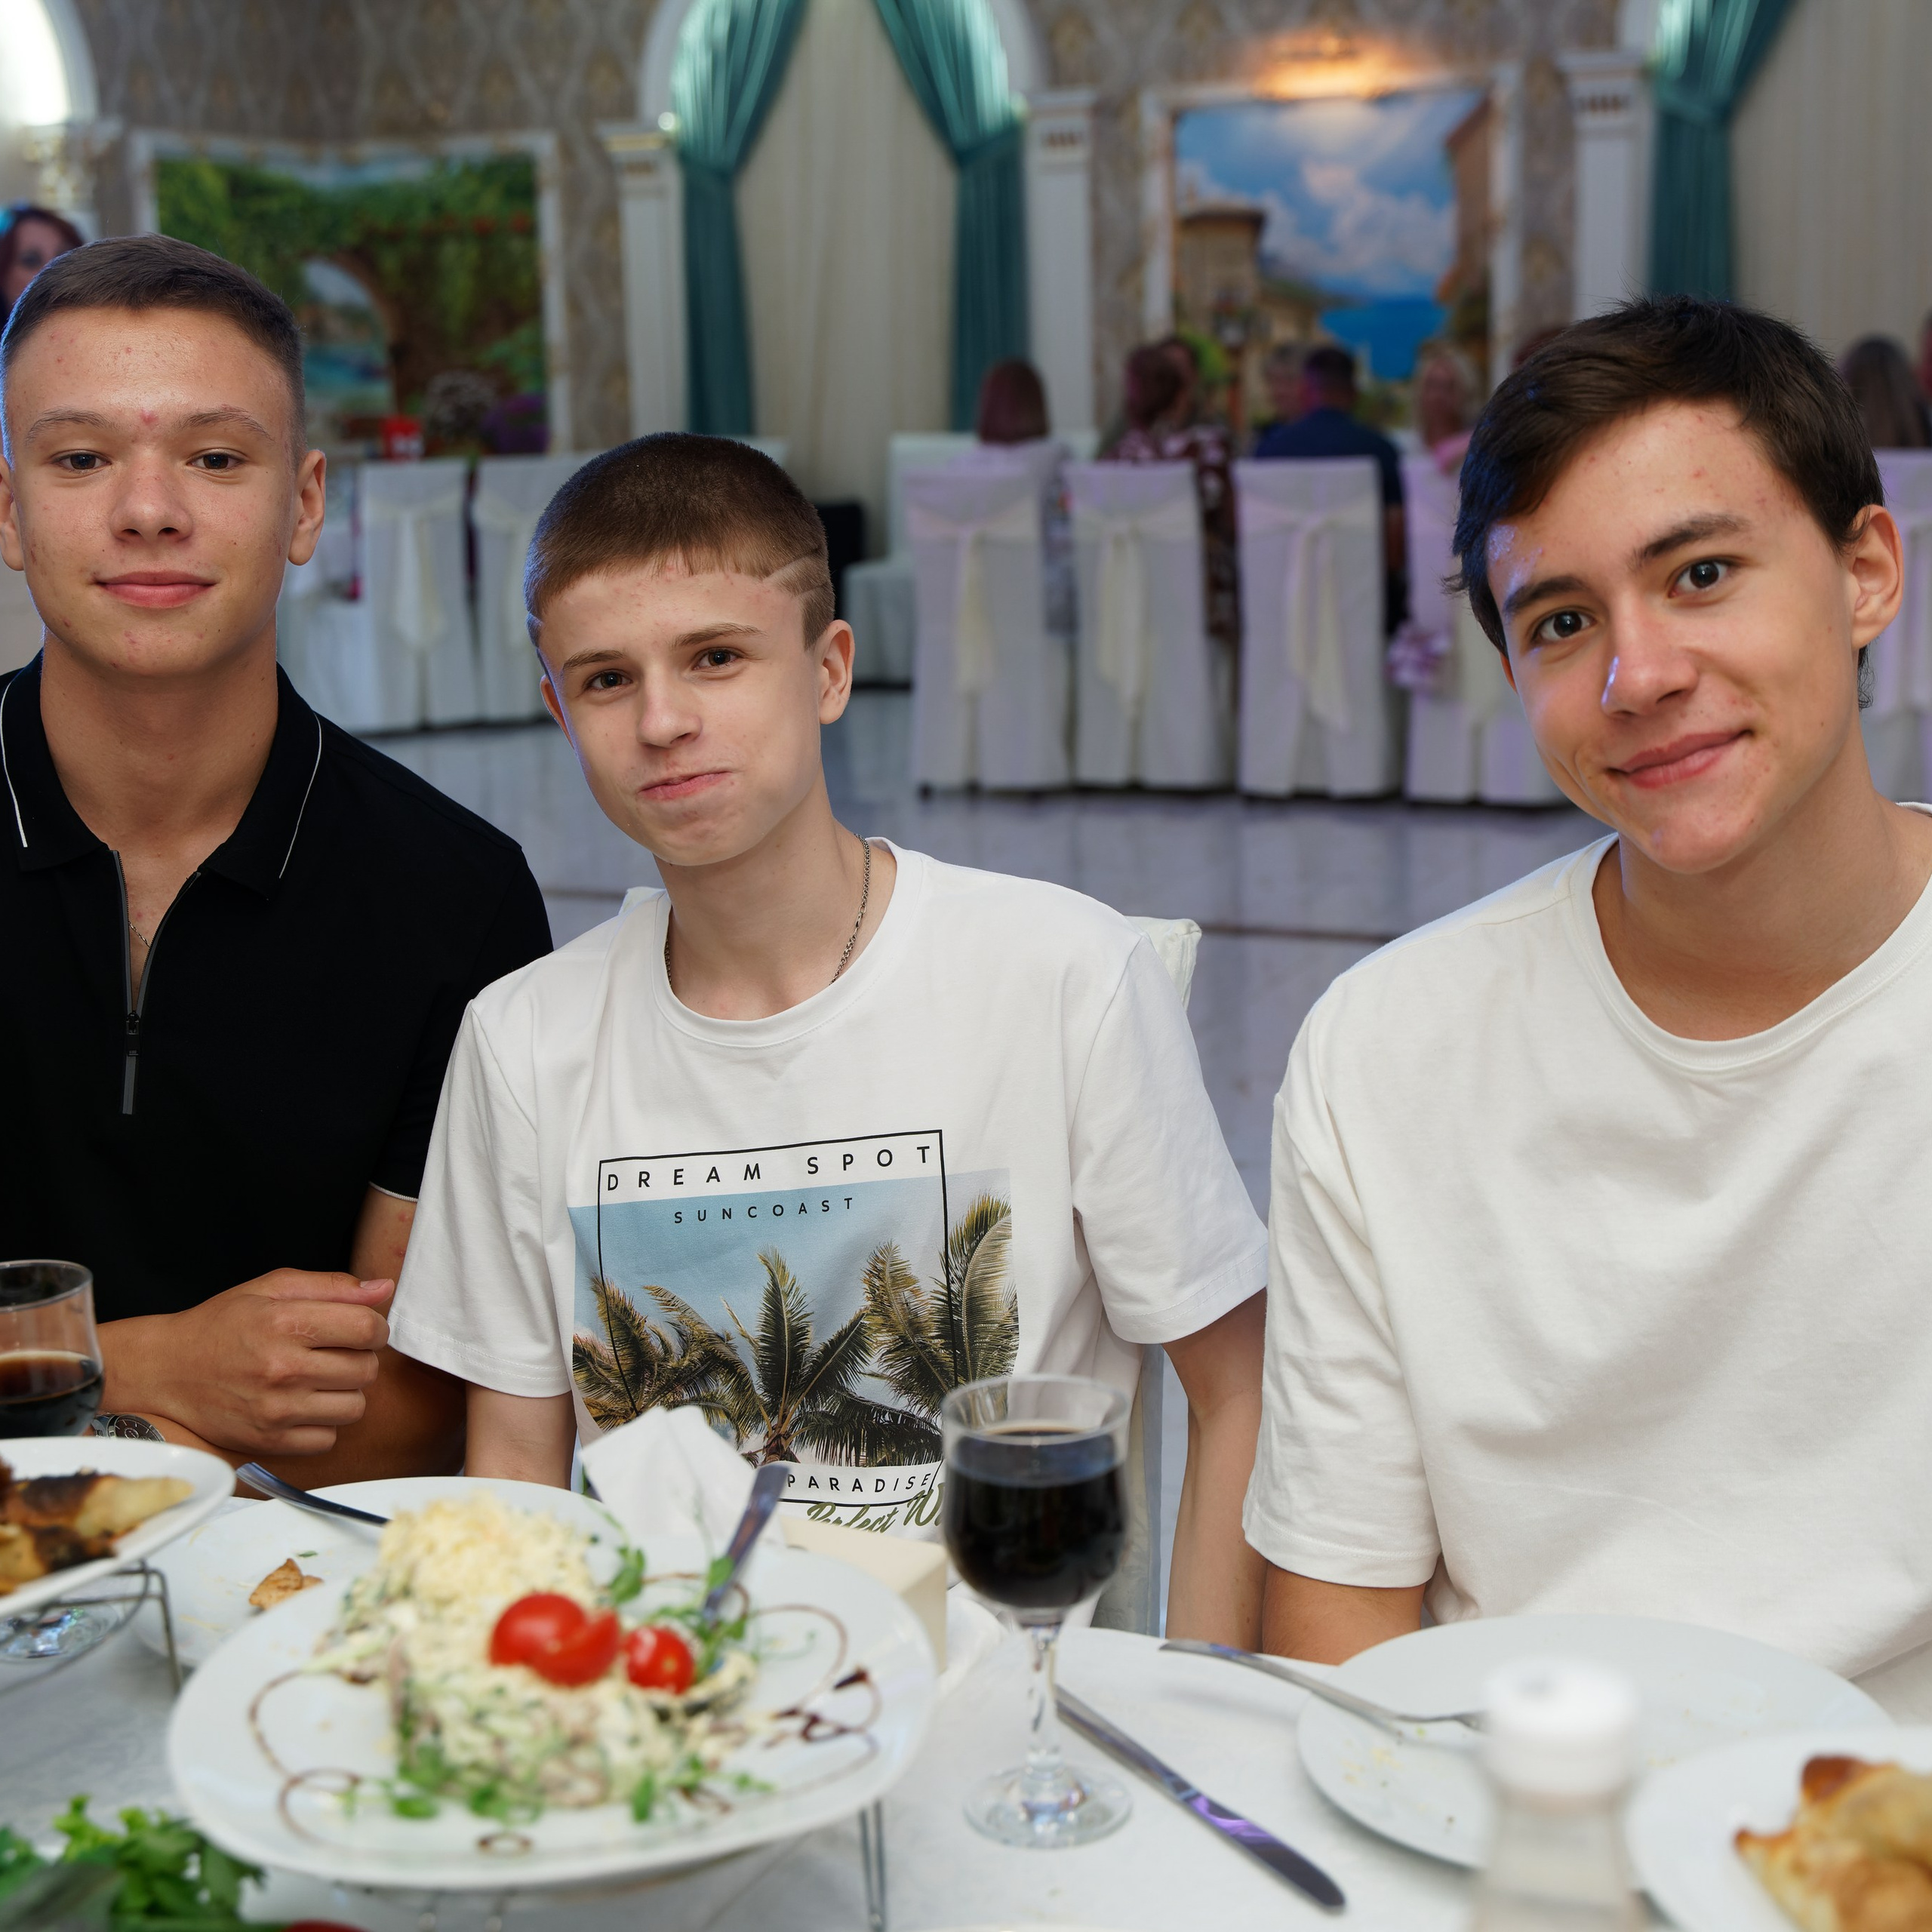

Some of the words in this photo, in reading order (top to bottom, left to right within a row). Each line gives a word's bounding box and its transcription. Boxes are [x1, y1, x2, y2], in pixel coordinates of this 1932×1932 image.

[607, 1163, 761, 1192] DREAM
[807, 1146, 930, 1175] SPOT
[673, 1197, 854, 1224] SUNCOAST
[787, 1472, 931, 1493] PARADISE
